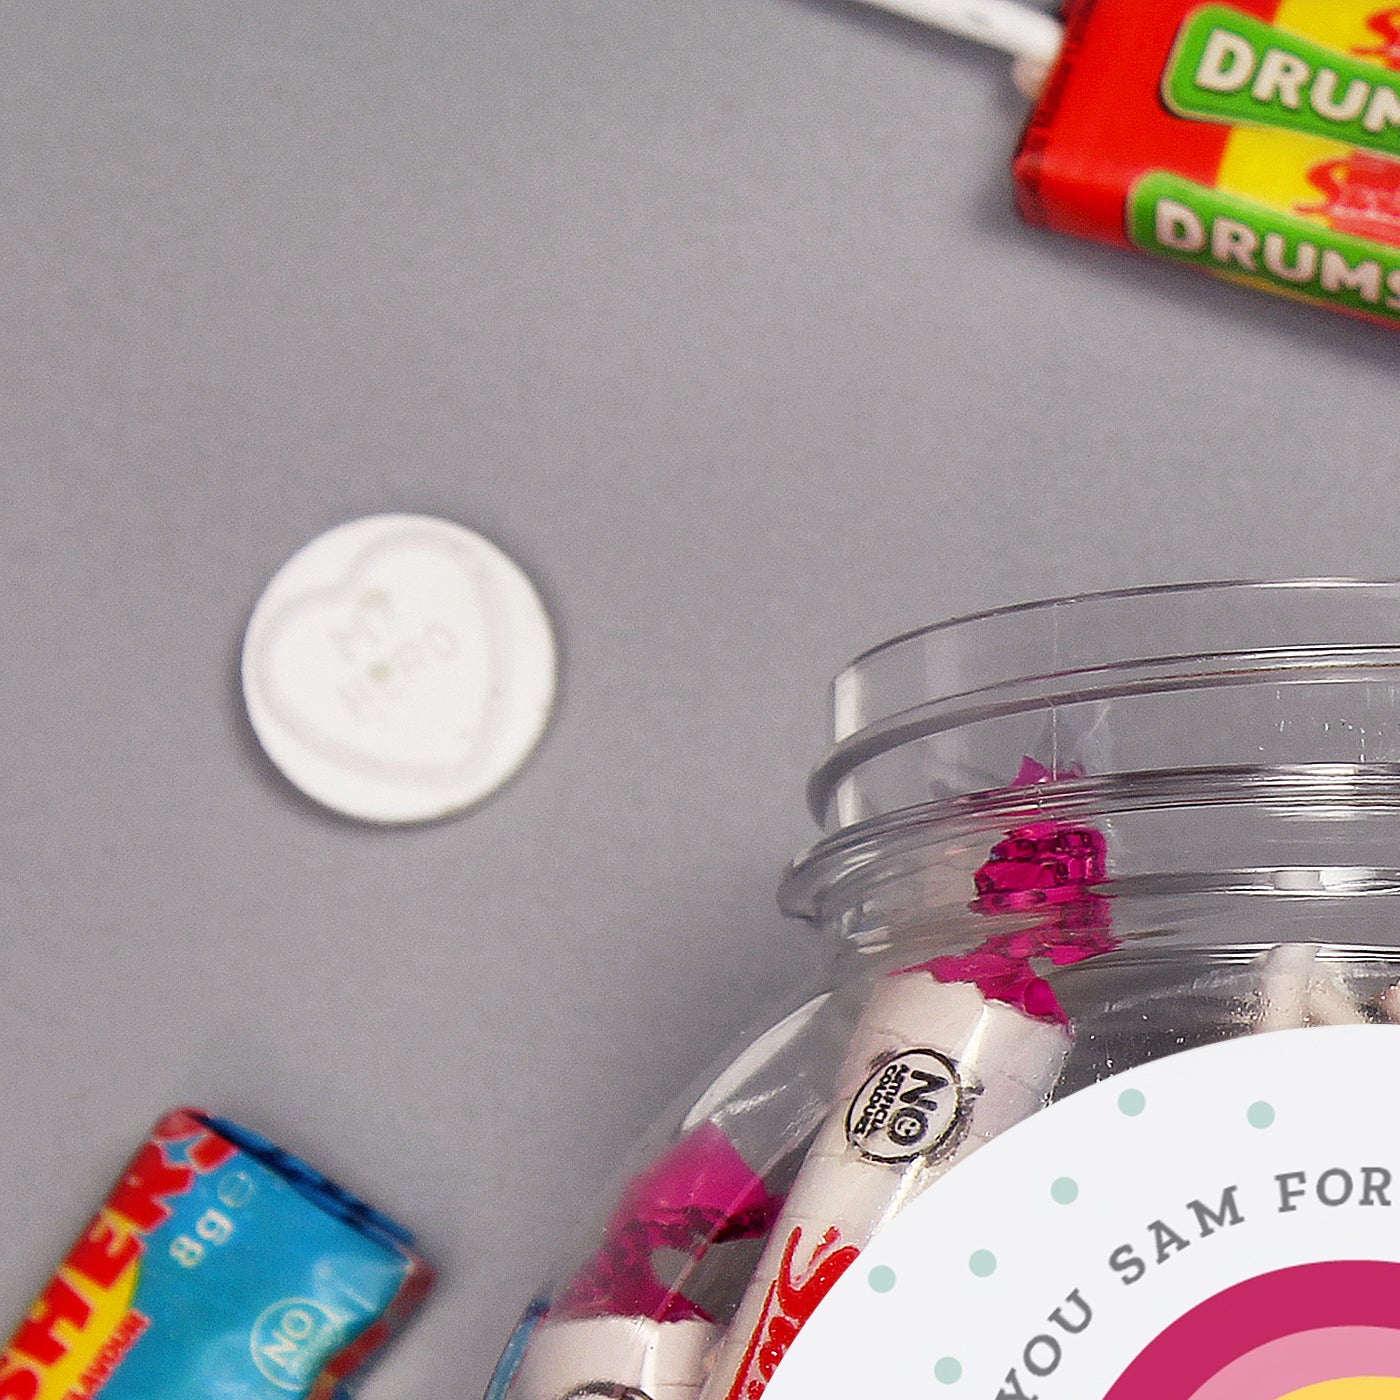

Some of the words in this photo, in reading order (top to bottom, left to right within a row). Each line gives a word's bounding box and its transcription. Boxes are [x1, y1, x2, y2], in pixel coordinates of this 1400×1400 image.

[887, 1070, 949, 1146] NO
[1109, 1185, 1244, 1285] SAM
[1275, 1167, 1391, 1212] FOR
[261, 1307, 315, 1376] NO
